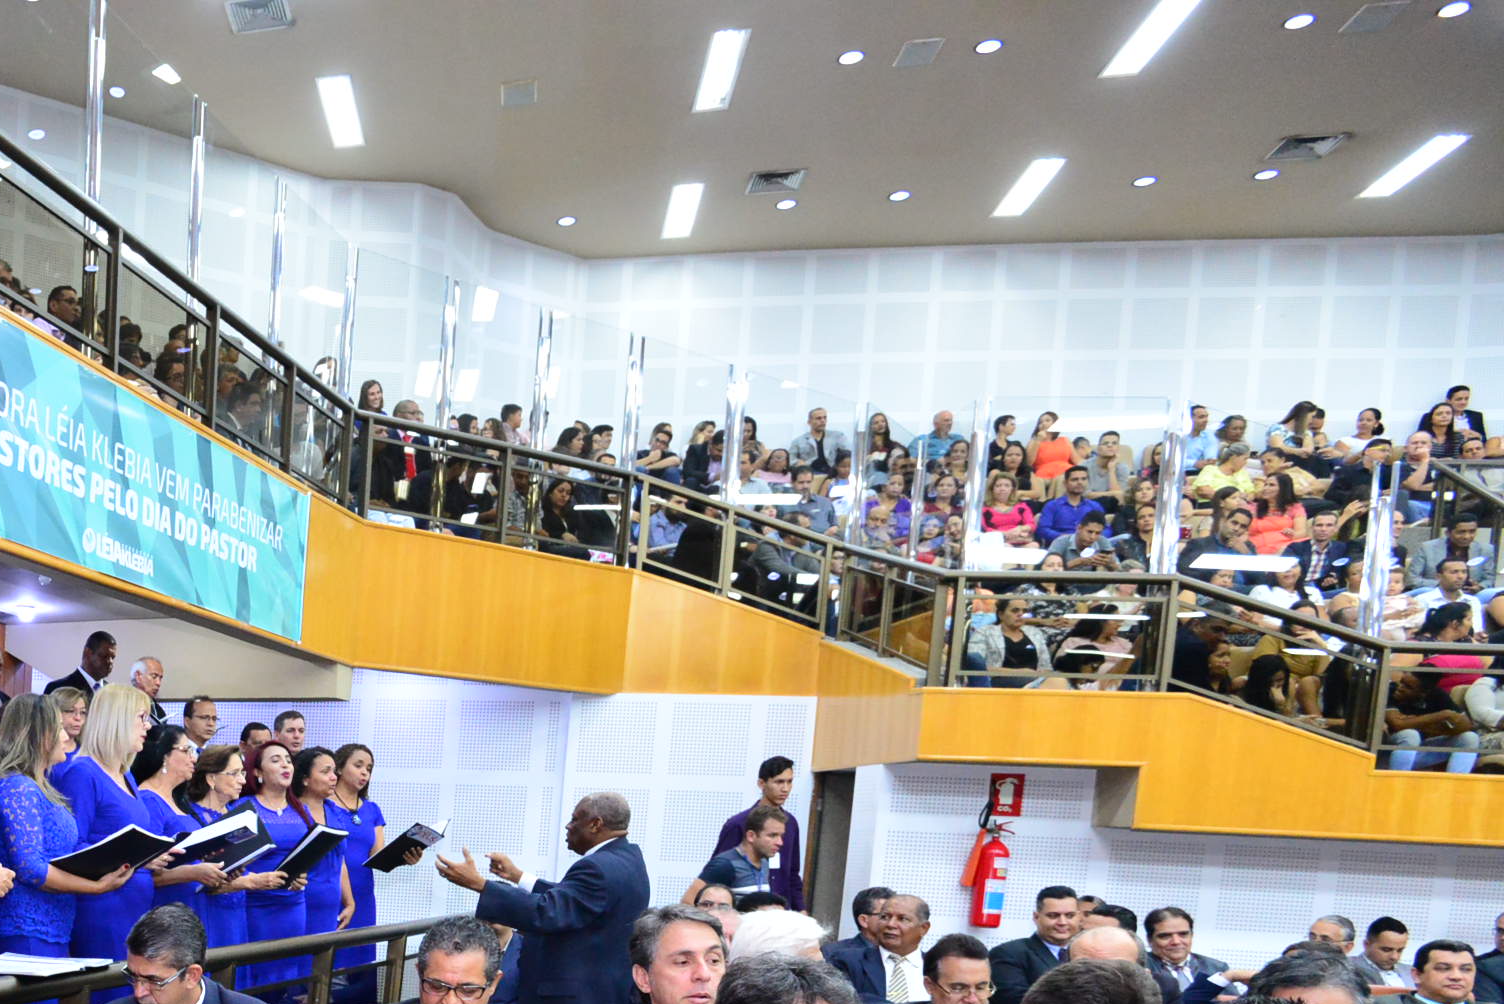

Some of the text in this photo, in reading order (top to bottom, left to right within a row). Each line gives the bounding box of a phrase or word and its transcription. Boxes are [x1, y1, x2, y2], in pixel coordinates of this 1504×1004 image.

[45, 405, 88, 457] LÉIA
[92, 429, 153, 489] KLEBIA
[155, 462, 190, 506] VEM
[193, 483, 284, 552] PARABENIZAR
[89, 471, 139, 521] PELO
[141, 496, 172, 537] DIA
[174, 511, 198, 547] DO
[200, 523, 258, 573] PASTOR
